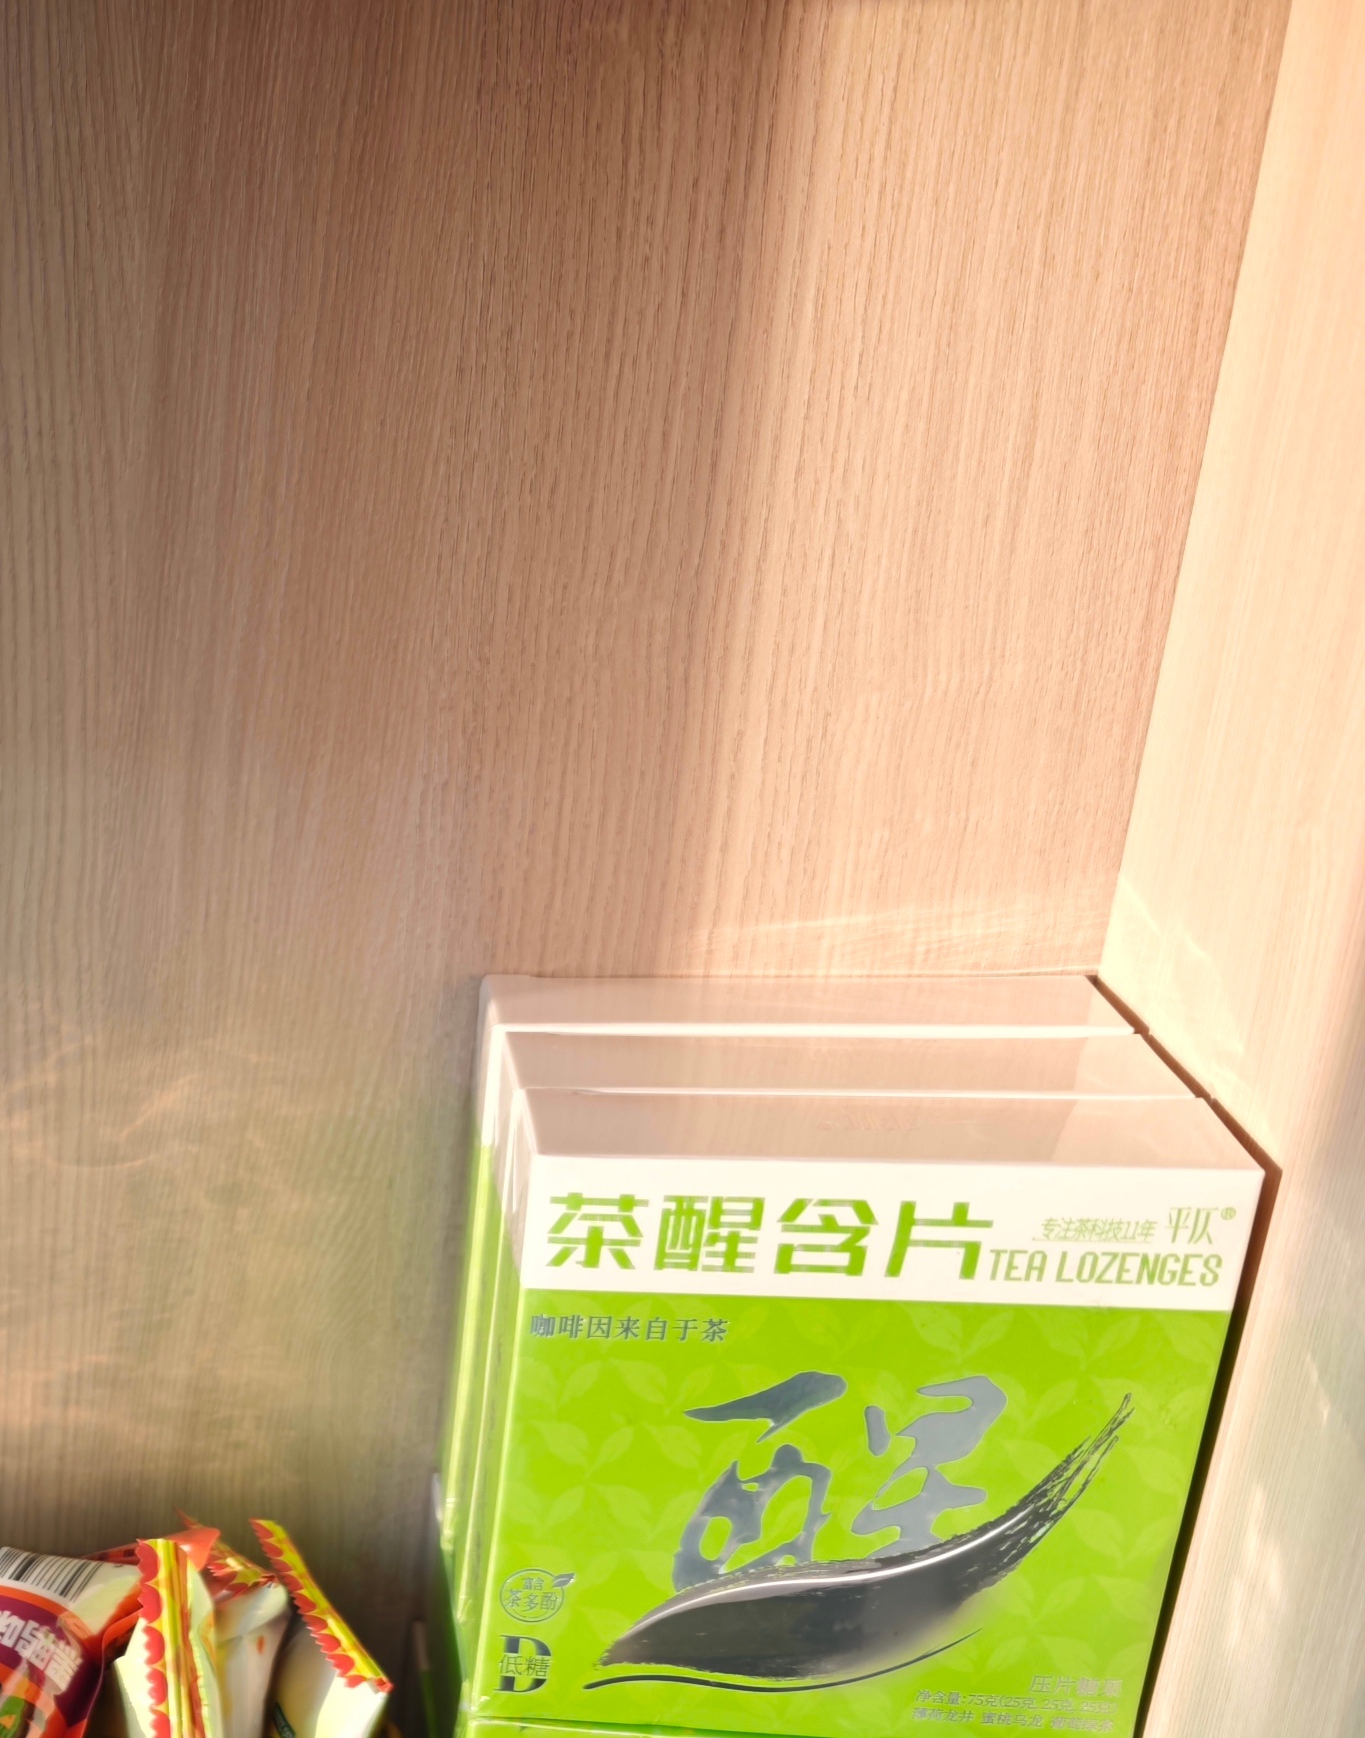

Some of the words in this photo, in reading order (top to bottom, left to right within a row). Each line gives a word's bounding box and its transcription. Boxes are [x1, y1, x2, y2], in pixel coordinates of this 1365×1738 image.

[547, 1191, 994, 1283] 茶醒含片
[1041, 1217, 1157, 1240] 专注茶科技11年
[990, 1249, 1047, 1282] TEA
[1055, 1251, 1223, 1286] LOZENGES
[530, 1313, 729, 1345] 咖啡因来自于茶
[506, 1589, 558, 1612] 茶多酚
[499, 1655, 550, 1677] 低糖
[1029, 1675, 1123, 1697] 压片糖果
[912, 1707, 974, 1723] 薄荷龙井
[981, 1711, 1044, 1728] 蜜桃乌龙
